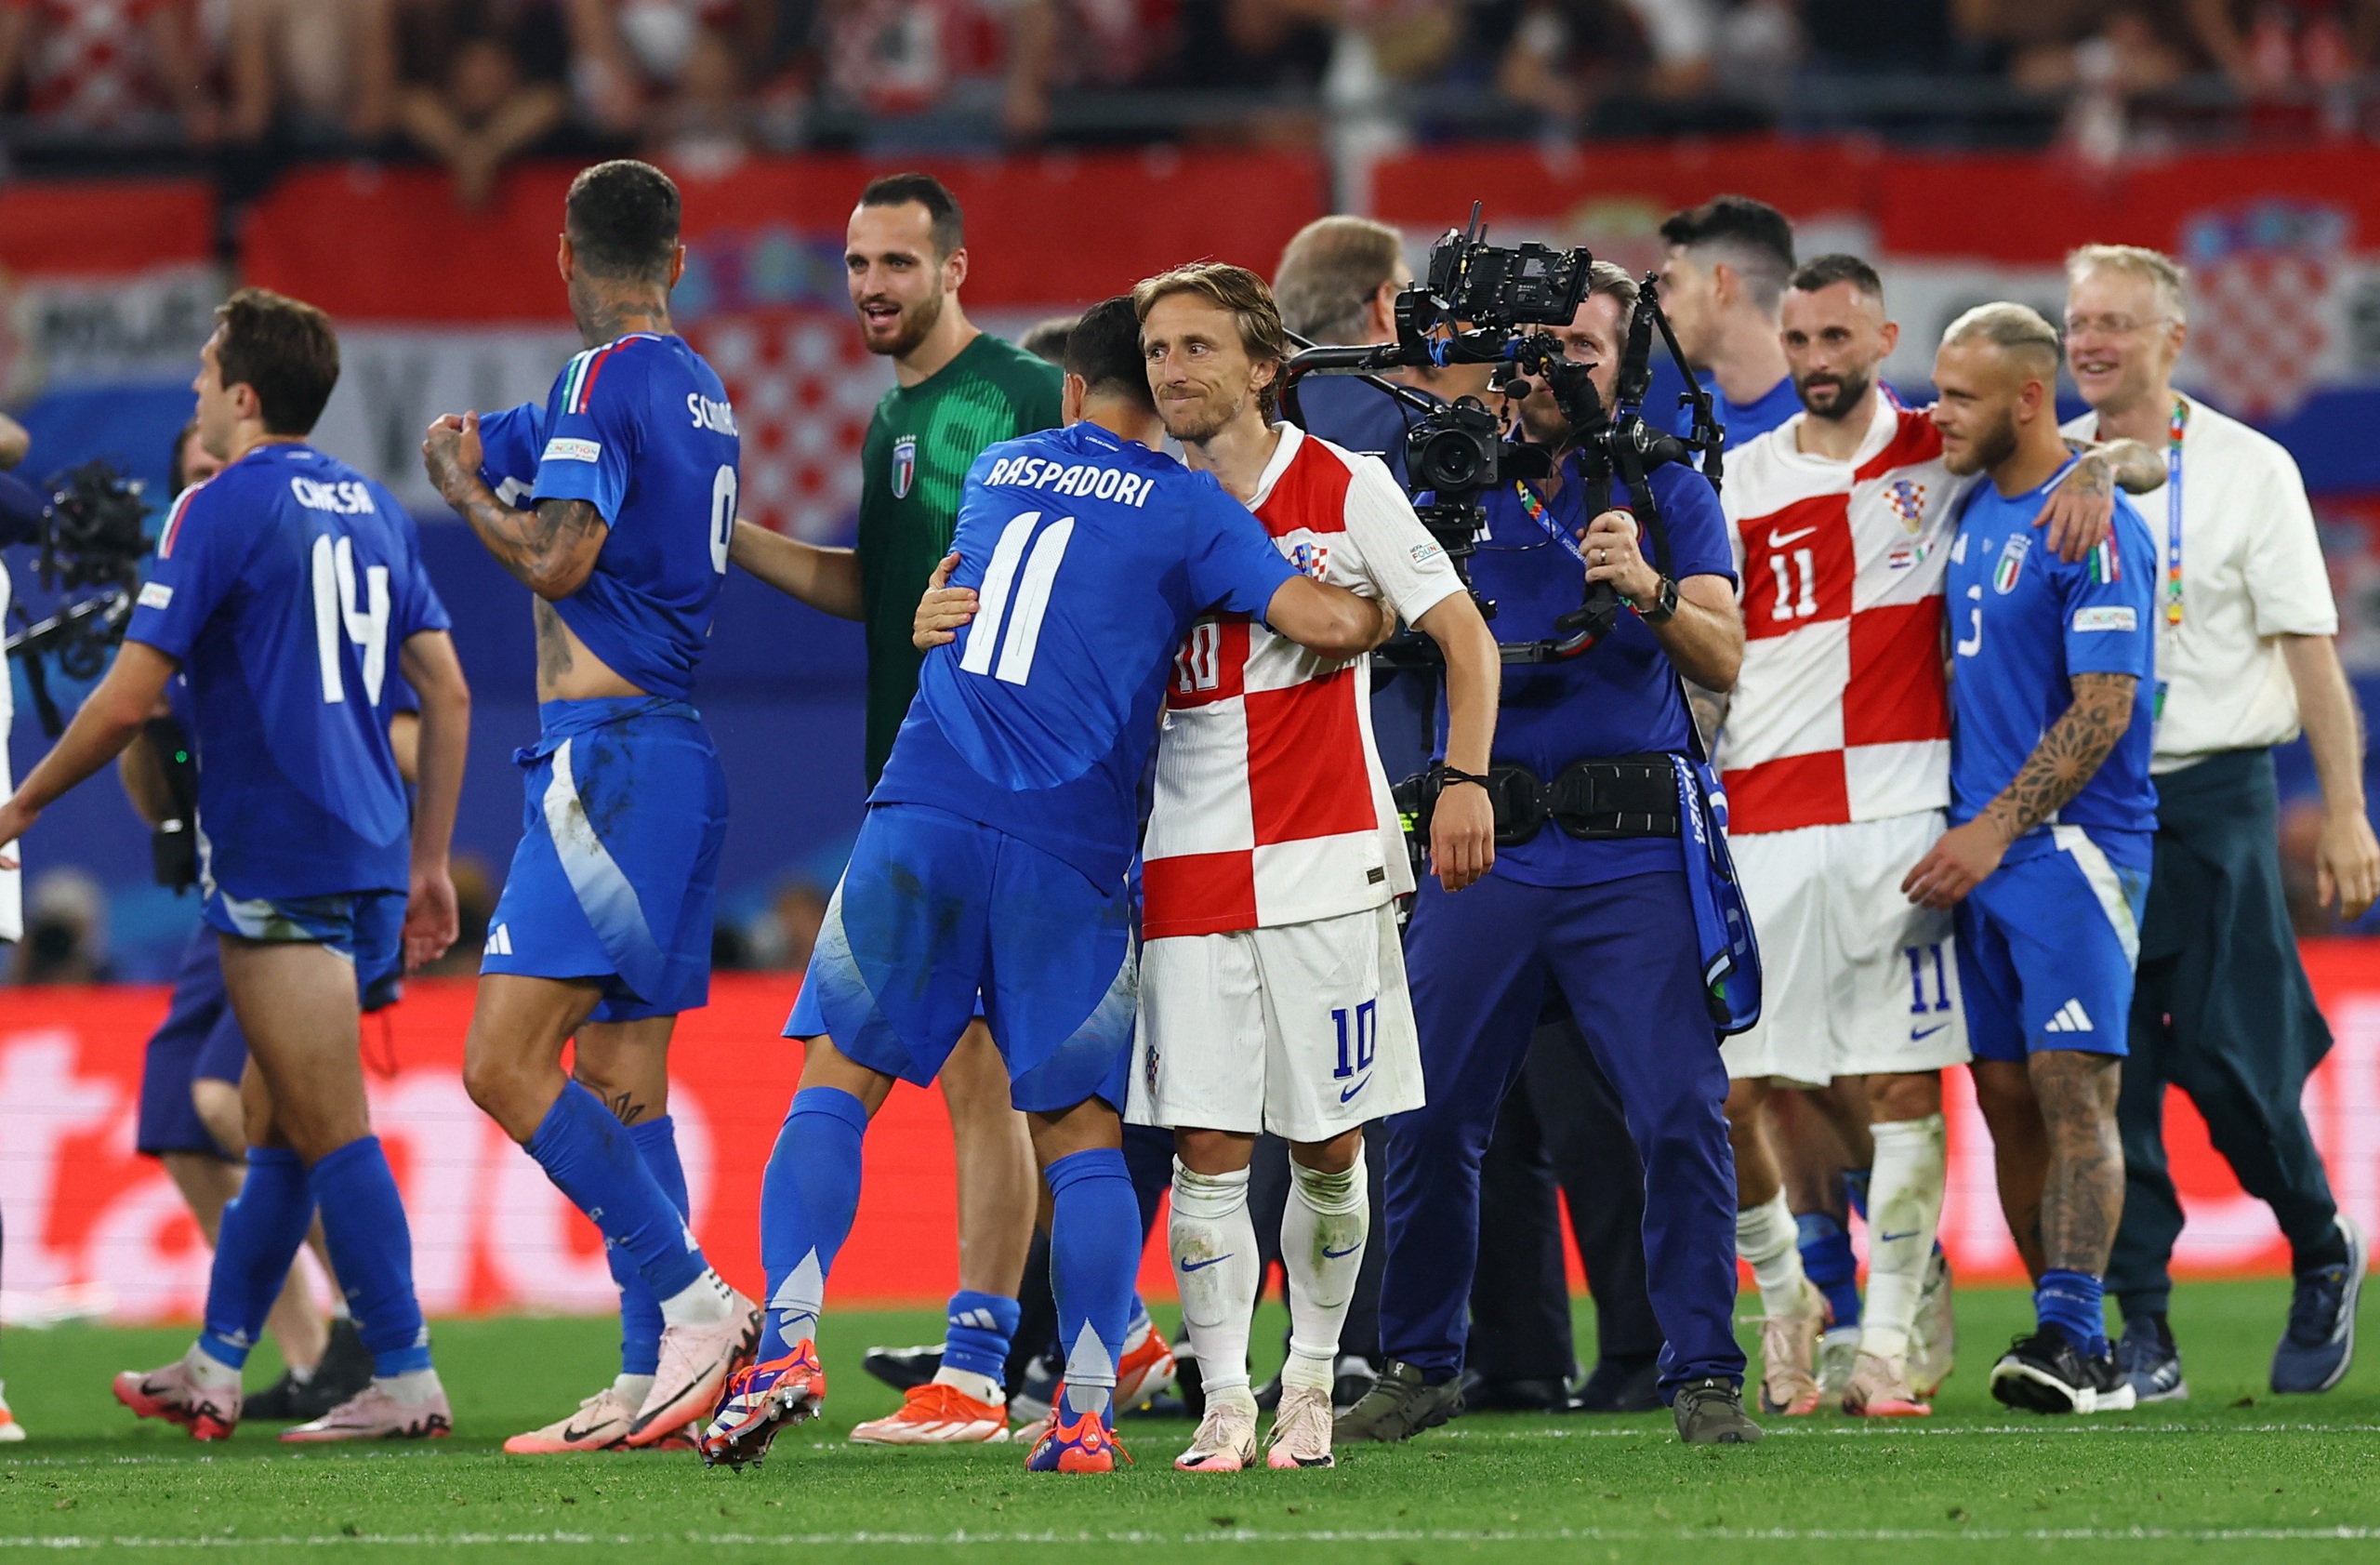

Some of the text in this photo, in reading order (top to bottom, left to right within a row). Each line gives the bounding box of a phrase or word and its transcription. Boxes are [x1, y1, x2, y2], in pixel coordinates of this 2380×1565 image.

[983, 456, 1155, 509] RASPADORI
[312, 532, 390, 707] 14
[959, 511, 1076, 686] 11
[1768, 548, 1818, 622] 11
[1174, 615, 1221, 695] 10
[1904, 944, 1951, 1014] 11
[1330, 997, 1377, 1081] 10
